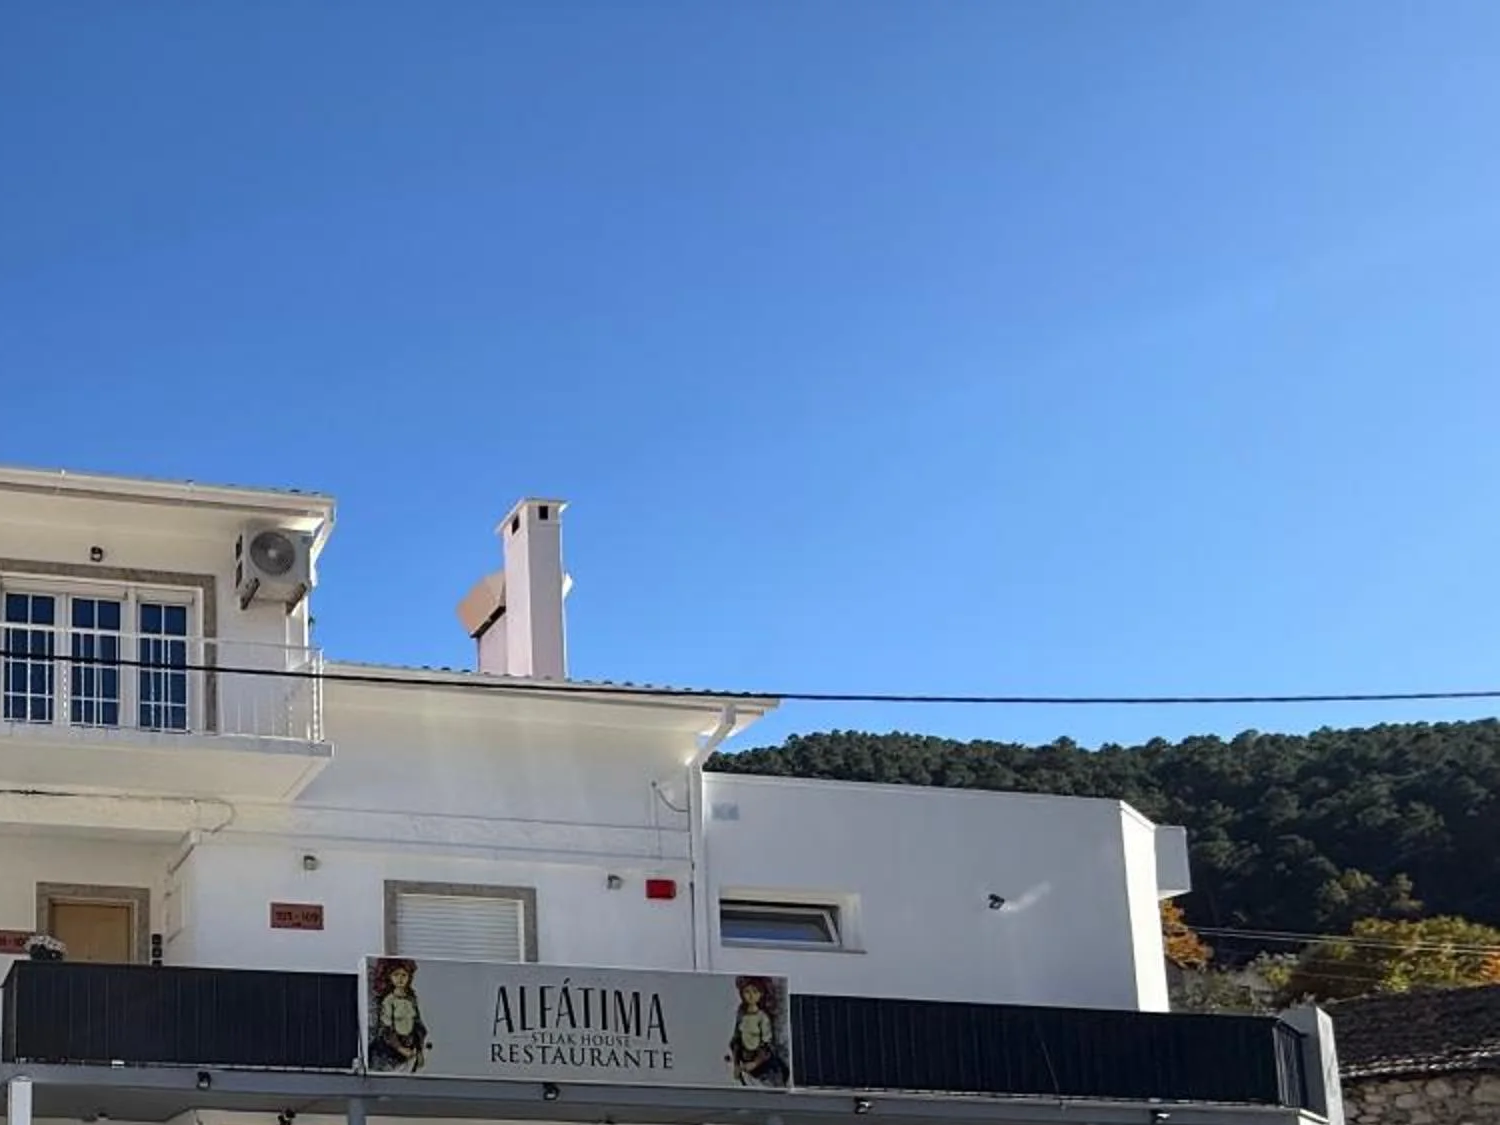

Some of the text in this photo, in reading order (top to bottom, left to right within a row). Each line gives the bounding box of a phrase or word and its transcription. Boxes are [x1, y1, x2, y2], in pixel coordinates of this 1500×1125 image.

[493, 977, 669, 1044] ALFÁTIMA
[532, 1031, 631, 1048] STEAK HOUSE
[491, 1043, 674, 1070] RESTAURANTE
